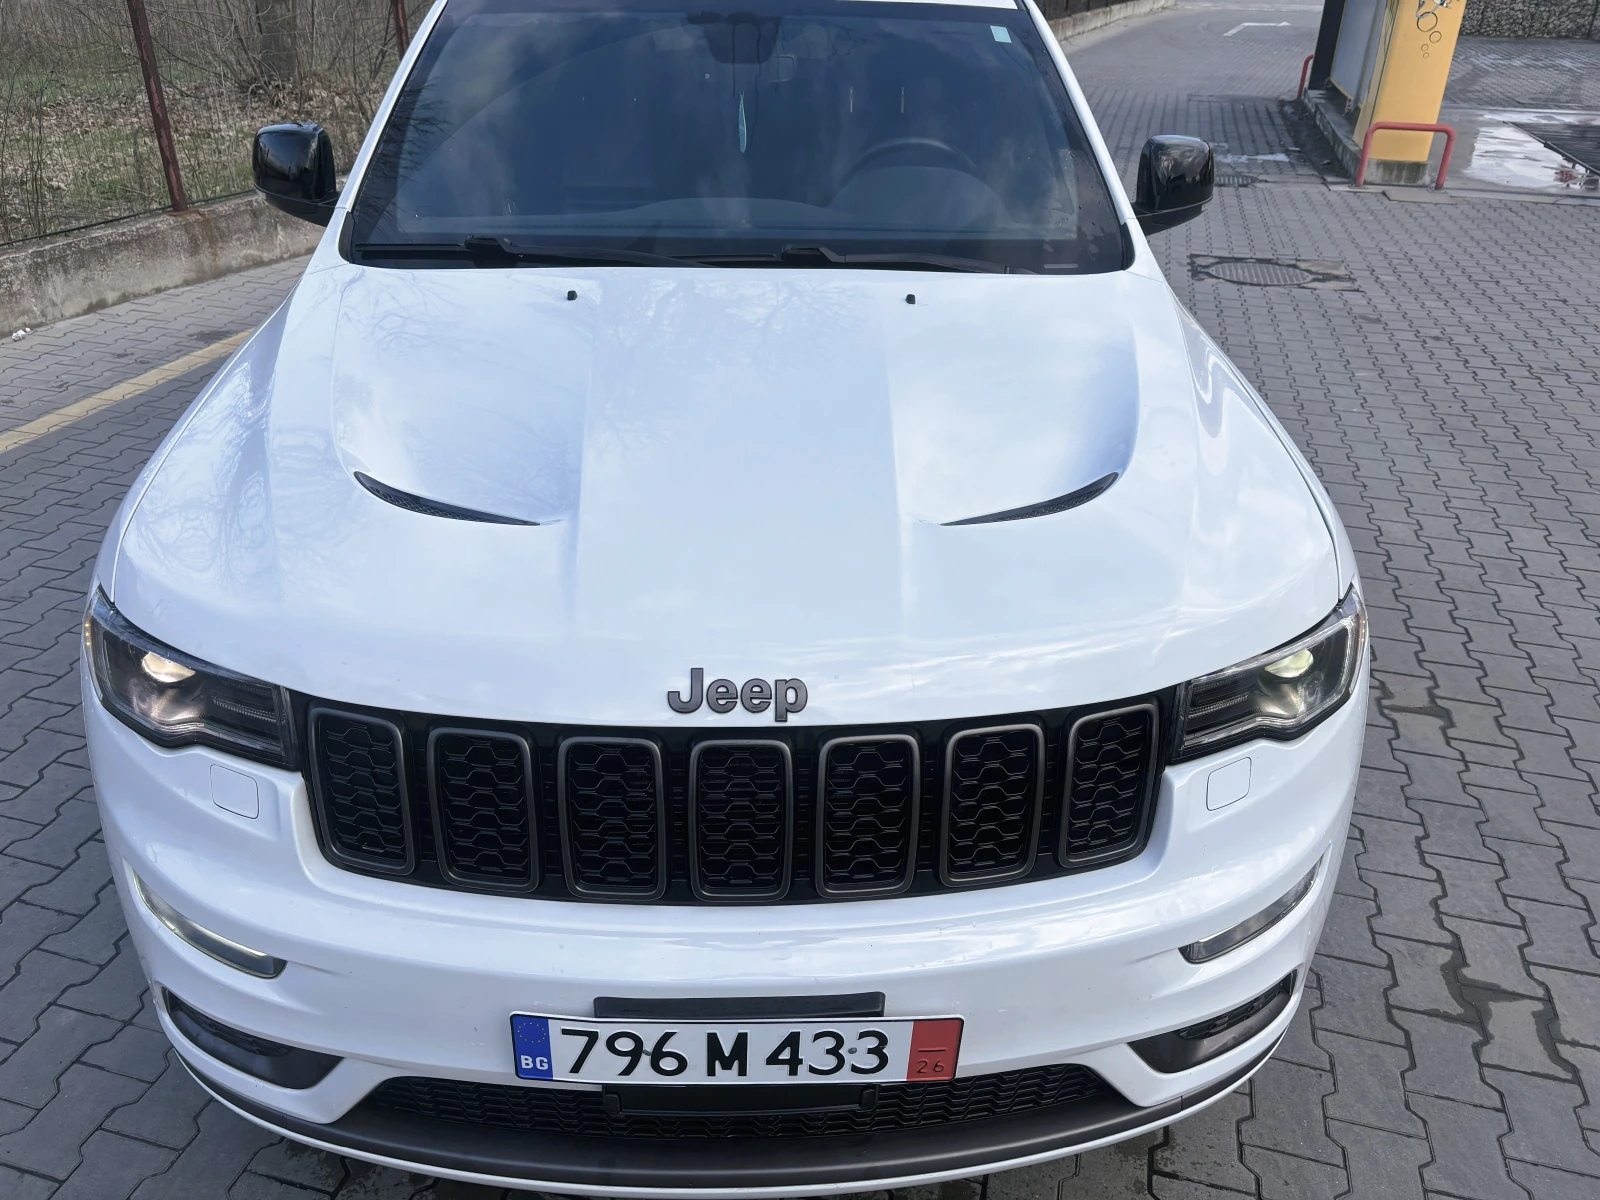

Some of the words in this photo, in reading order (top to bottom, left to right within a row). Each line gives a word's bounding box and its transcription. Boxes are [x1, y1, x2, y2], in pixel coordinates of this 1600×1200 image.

[667, 667, 808, 722] Jeep
[520, 1054, 549, 1071] BG
[561, 1028, 688, 1076] 796
[706, 1031, 748, 1076] M
[765, 1030, 889, 1076] 433
[916, 1059, 945, 1074] 26
